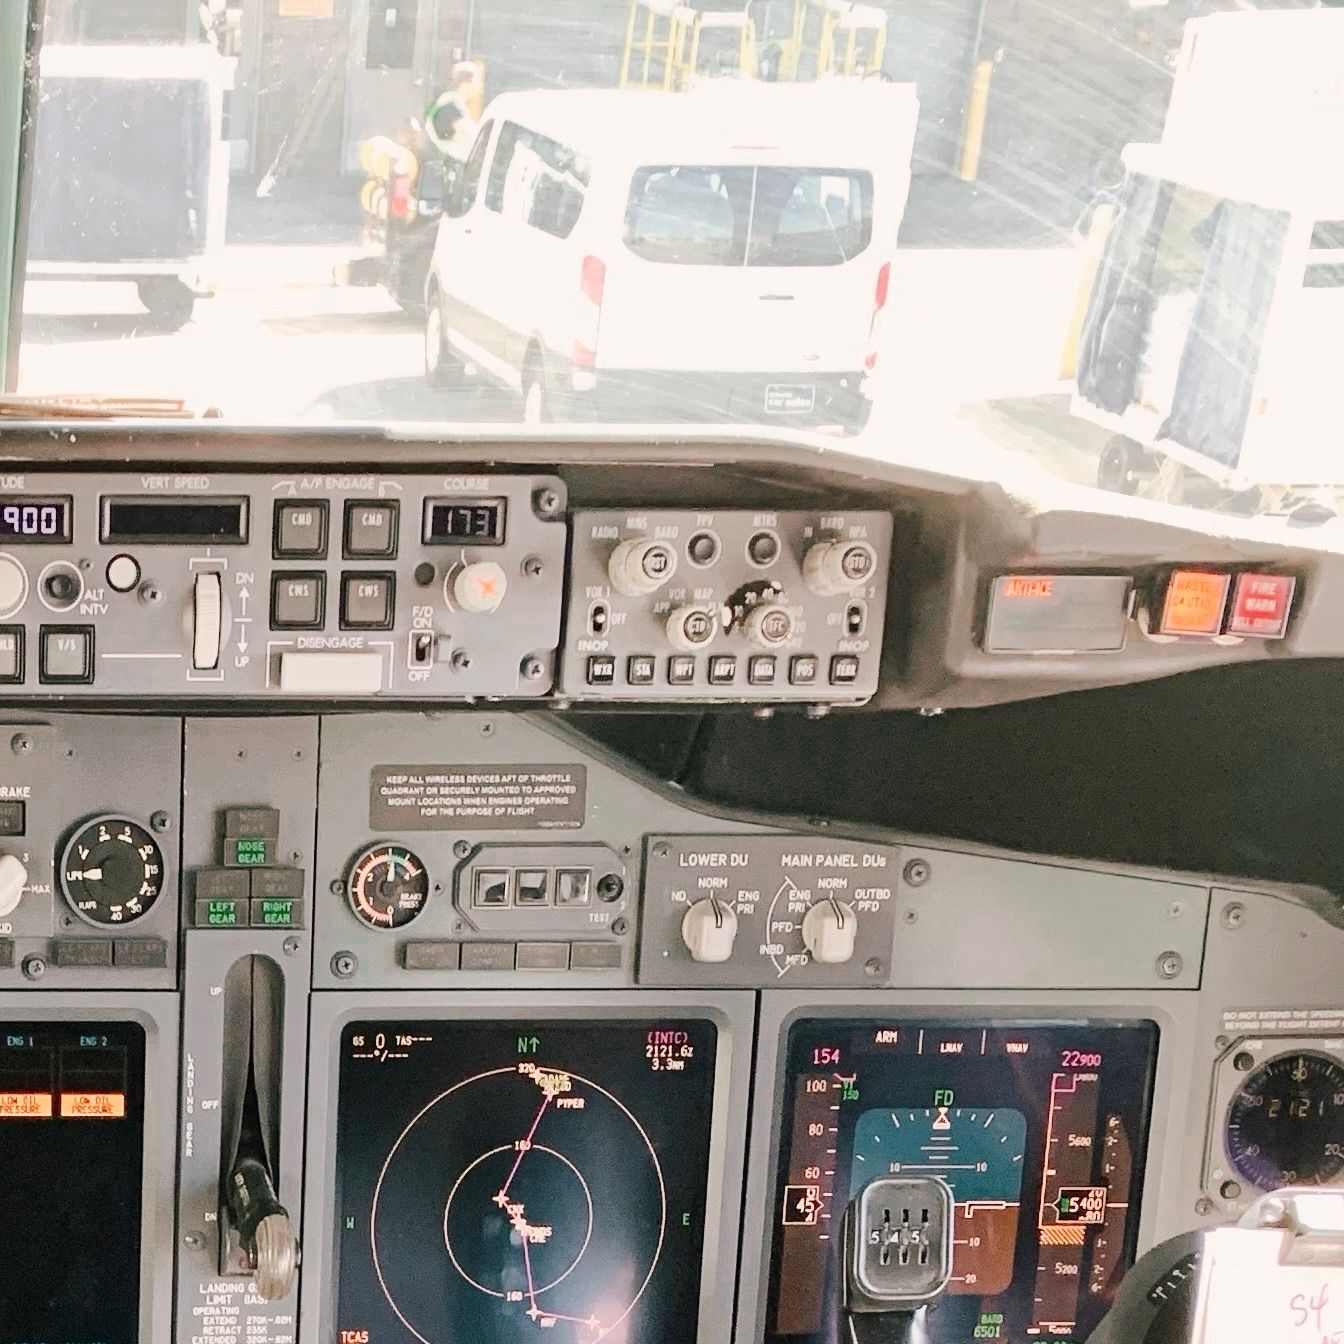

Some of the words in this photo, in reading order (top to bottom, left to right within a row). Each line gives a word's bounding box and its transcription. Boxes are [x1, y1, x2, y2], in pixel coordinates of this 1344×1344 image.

[142, 477, 171, 490] VERT
[174, 477, 209, 490] SPEED
[300, 477, 321, 490] A/P
[324, 477, 374, 490] ENGAGE
[443, 478, 489, 490] COURSE
[445, 509, 491, 536] 173
[1005, 580, 1052, 596] ANTI-ICE
[297, 637, 363, 649] DISENGAGE
[387, 776, 408, 784] KEEP
[409, 776, 423, 784] ALL
[425, 775, 465, 784] WIRELESS
[466, 775, 500, 783] DEVICES
[502, 775, 516, 783] AFT
[518, 775, 529, 783] OF
[531, 775, 571, 783] THROTTLE
[238, 841, 265, 852] NOSE
[238, 852, 265, 864] GEAR
[679, 854, 722, 867] LOWER
[725, 854, 748, 867] DU
[781, 854, 811, 867] MAIN
[816, 854, 857, 867] PANEL
[862, 854, 887, 867] DUs
[698, 878, 727, 889] NORM
[210, 902, 235, 911] LEFT
[263, 901, 292, 911] RIGHT
[208, 912, 236, 923] GEAR
[264, 912, 291, 923] GEAR
[813, 1049, 839, 1064] 154
[1062, 1051, 1101, 1067] 22900
